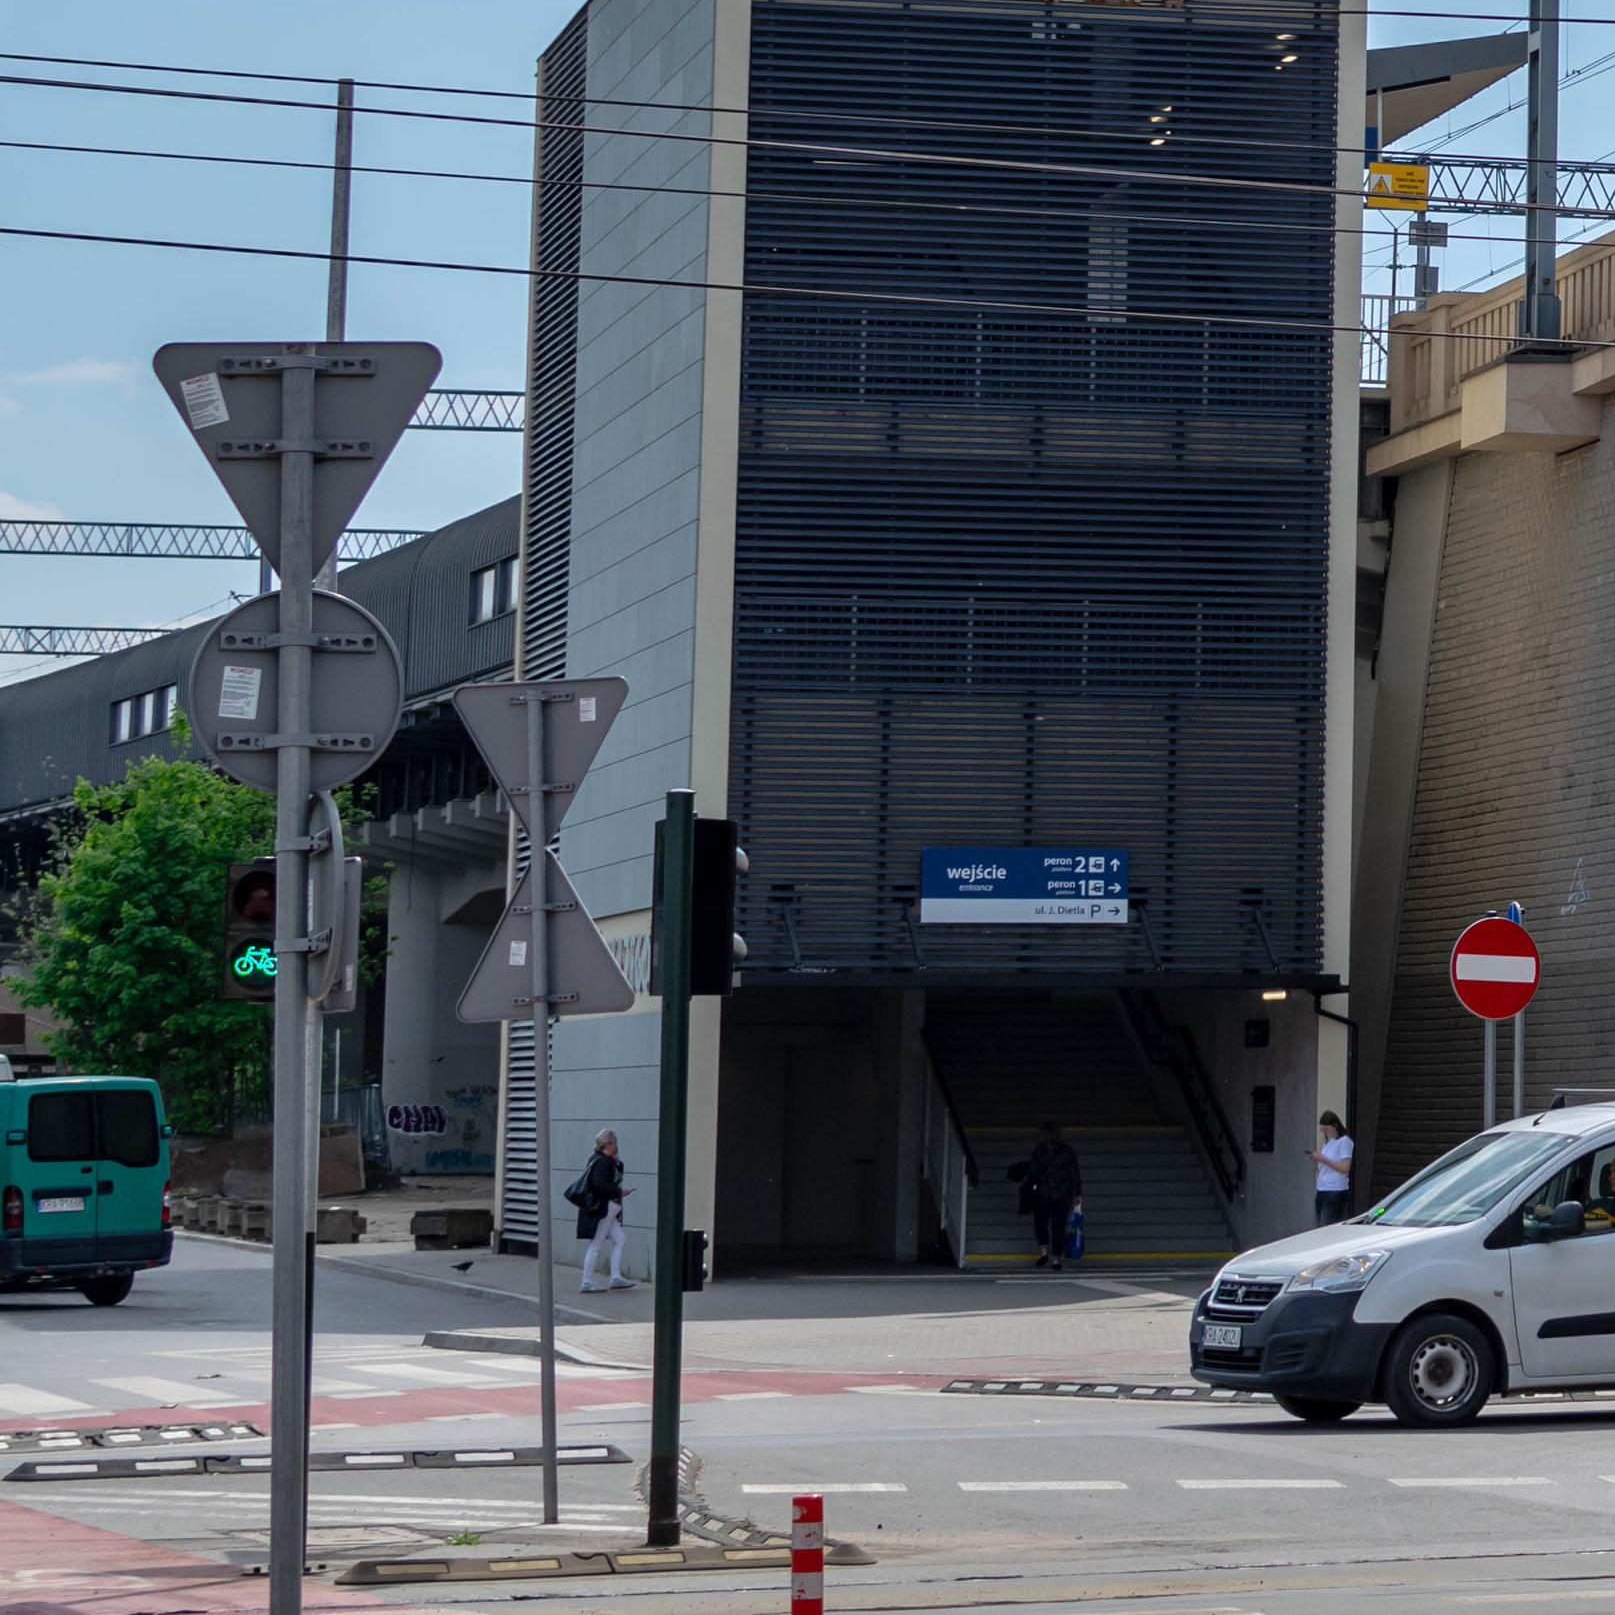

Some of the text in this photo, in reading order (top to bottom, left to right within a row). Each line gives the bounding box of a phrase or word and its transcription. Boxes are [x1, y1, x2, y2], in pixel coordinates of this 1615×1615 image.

[1044, 856, 1086, 873] peron 2
[946, 864, 1007, 883] wejście
[958, 884, 994, 892] entrance
[1047, 879, 1086, 896] peron 1
[1035, 905, 1047, 915] ul.
[1057, 905, 1085, 915] Dietla
